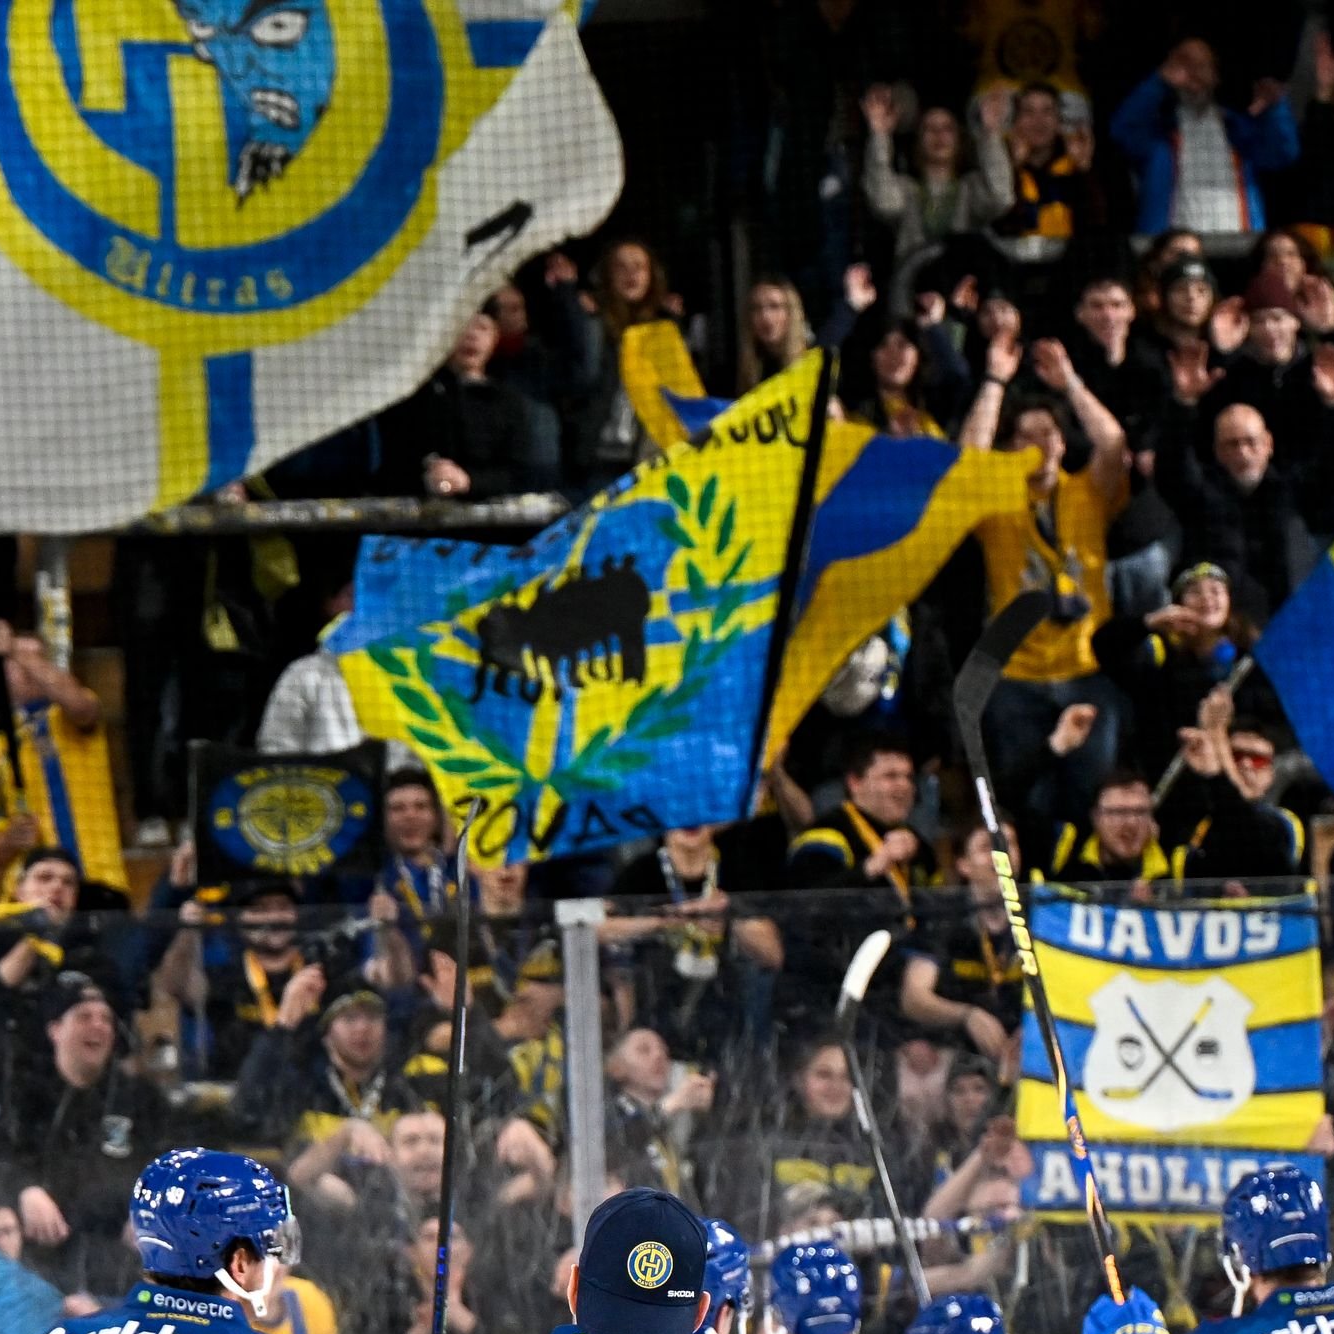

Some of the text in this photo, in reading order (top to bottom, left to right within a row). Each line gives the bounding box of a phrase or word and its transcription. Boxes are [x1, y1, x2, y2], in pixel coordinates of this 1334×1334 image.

[990, 850, 1038, 976] BAUER
[1068, 903, 1281, 960] DAVOS
[153, 1292, 234, 1320] enovetic
